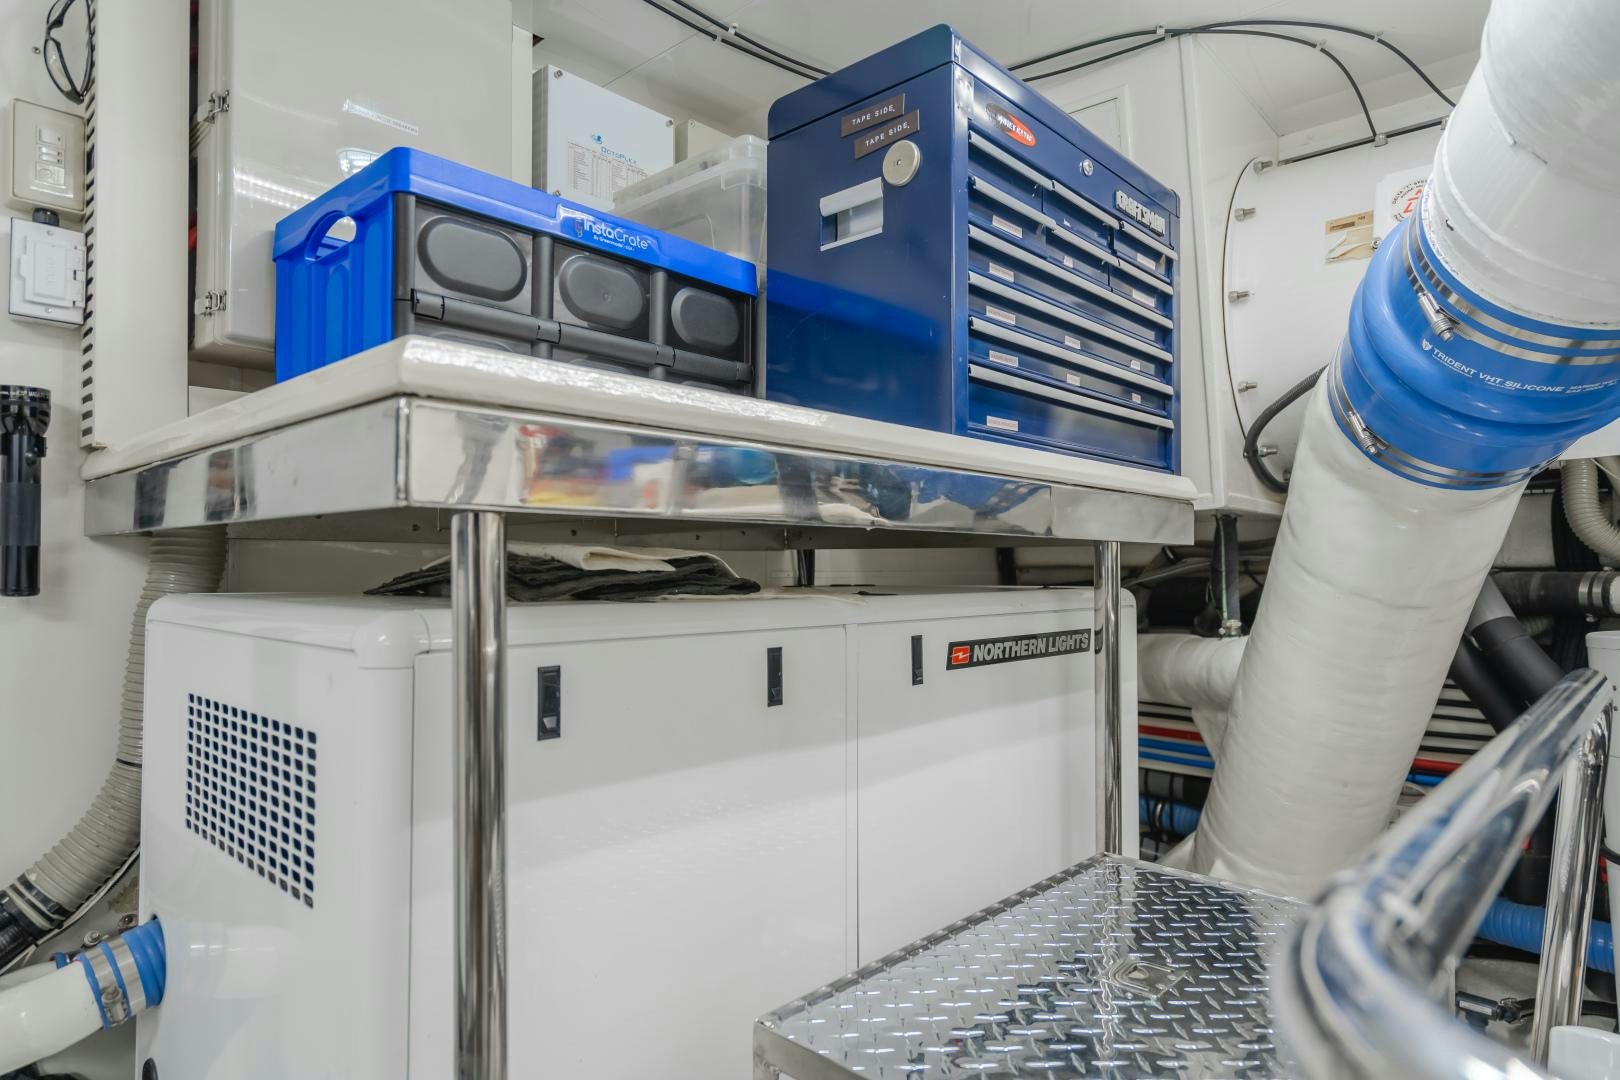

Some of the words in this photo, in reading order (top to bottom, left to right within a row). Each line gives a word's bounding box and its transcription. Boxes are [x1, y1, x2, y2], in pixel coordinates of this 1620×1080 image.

[852, 113, 871, 125] TAPE
[865, 132, 885, 147] TAPE
[1116, 190, 1166, 235] CRAFTSMAN
[583, 218, 649, 250] InstaCrate
[1433, 349, 1478, 376] TRIDENT
[1479, 372, 1503, 384] VHT
[1505, 380, 1566, 392] SILICONE
[973, 637, 1047, 662] NORTHERN
[1048, 633, 1089, 653] LIGHTS
